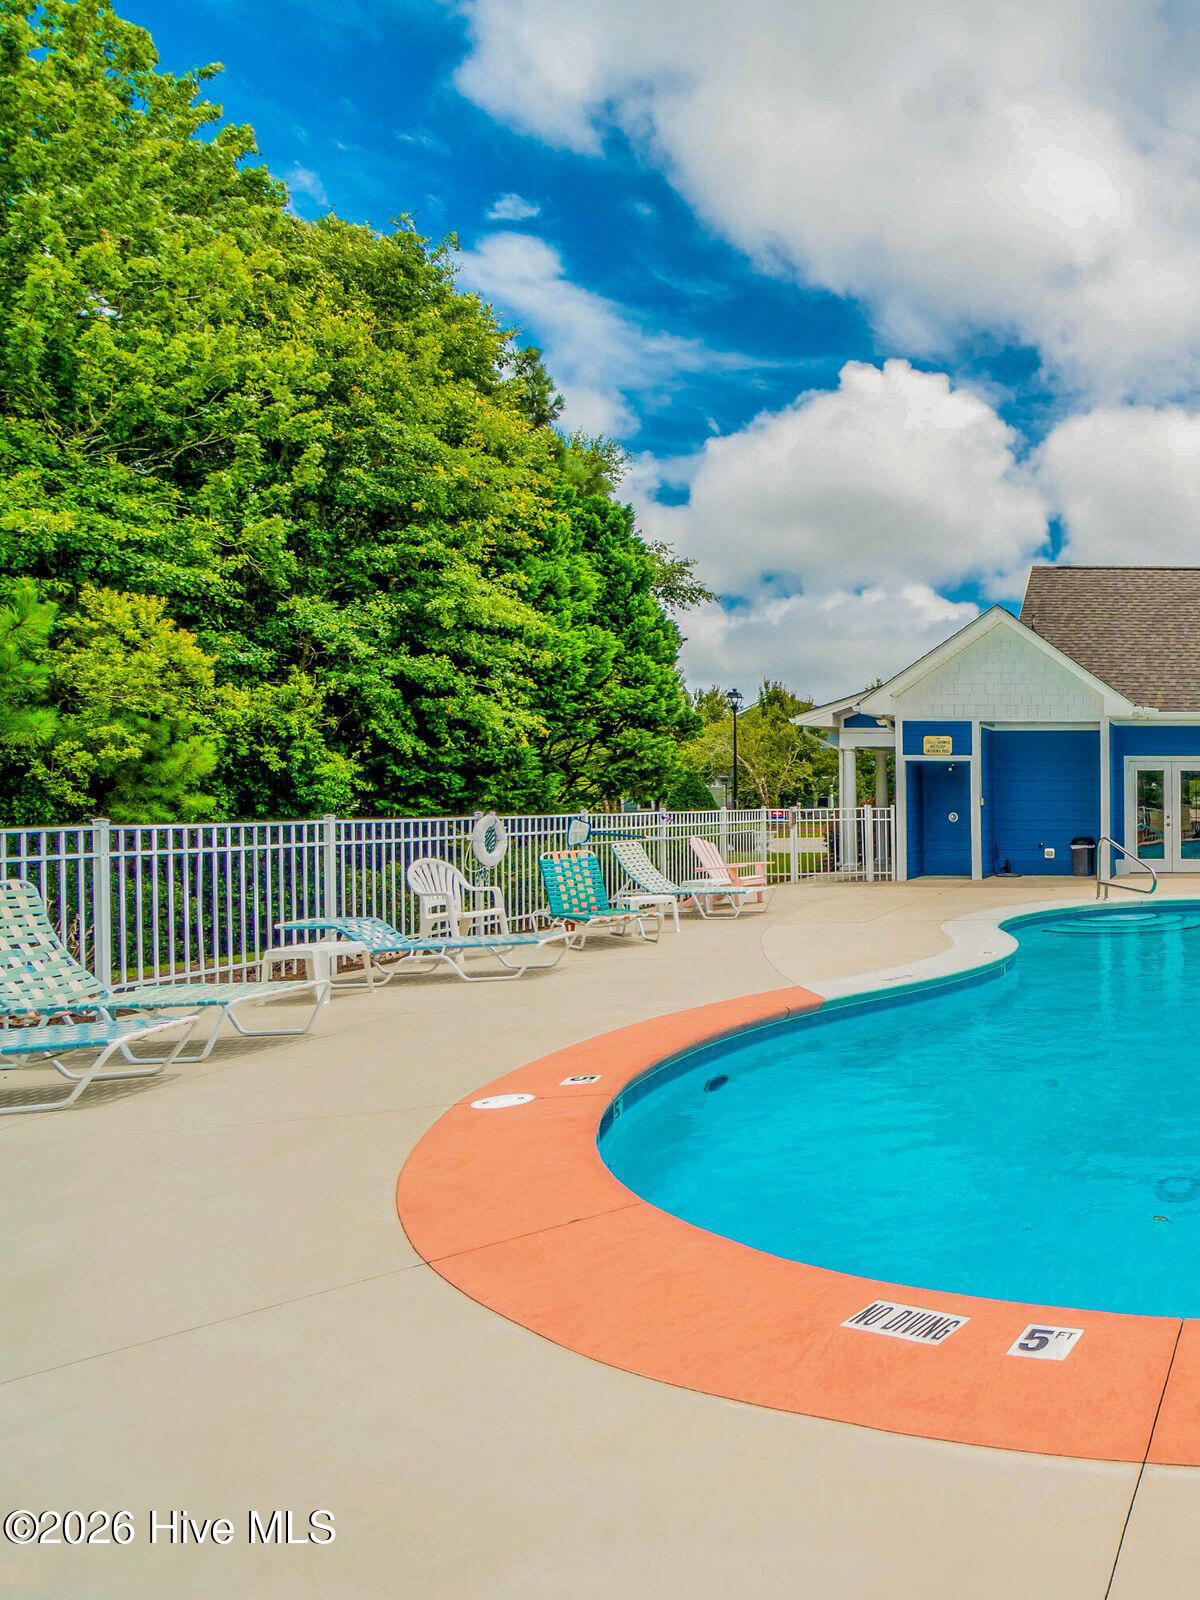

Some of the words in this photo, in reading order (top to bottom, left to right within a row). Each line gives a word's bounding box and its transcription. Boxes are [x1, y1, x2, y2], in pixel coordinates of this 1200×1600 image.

[848, 1303, 894, 1326] NO
[880, 1310, 960, 1341] DIVING
[1018, 1328, 1056, 1352] 5
[1055, 1331, 1077, 1341] FT
